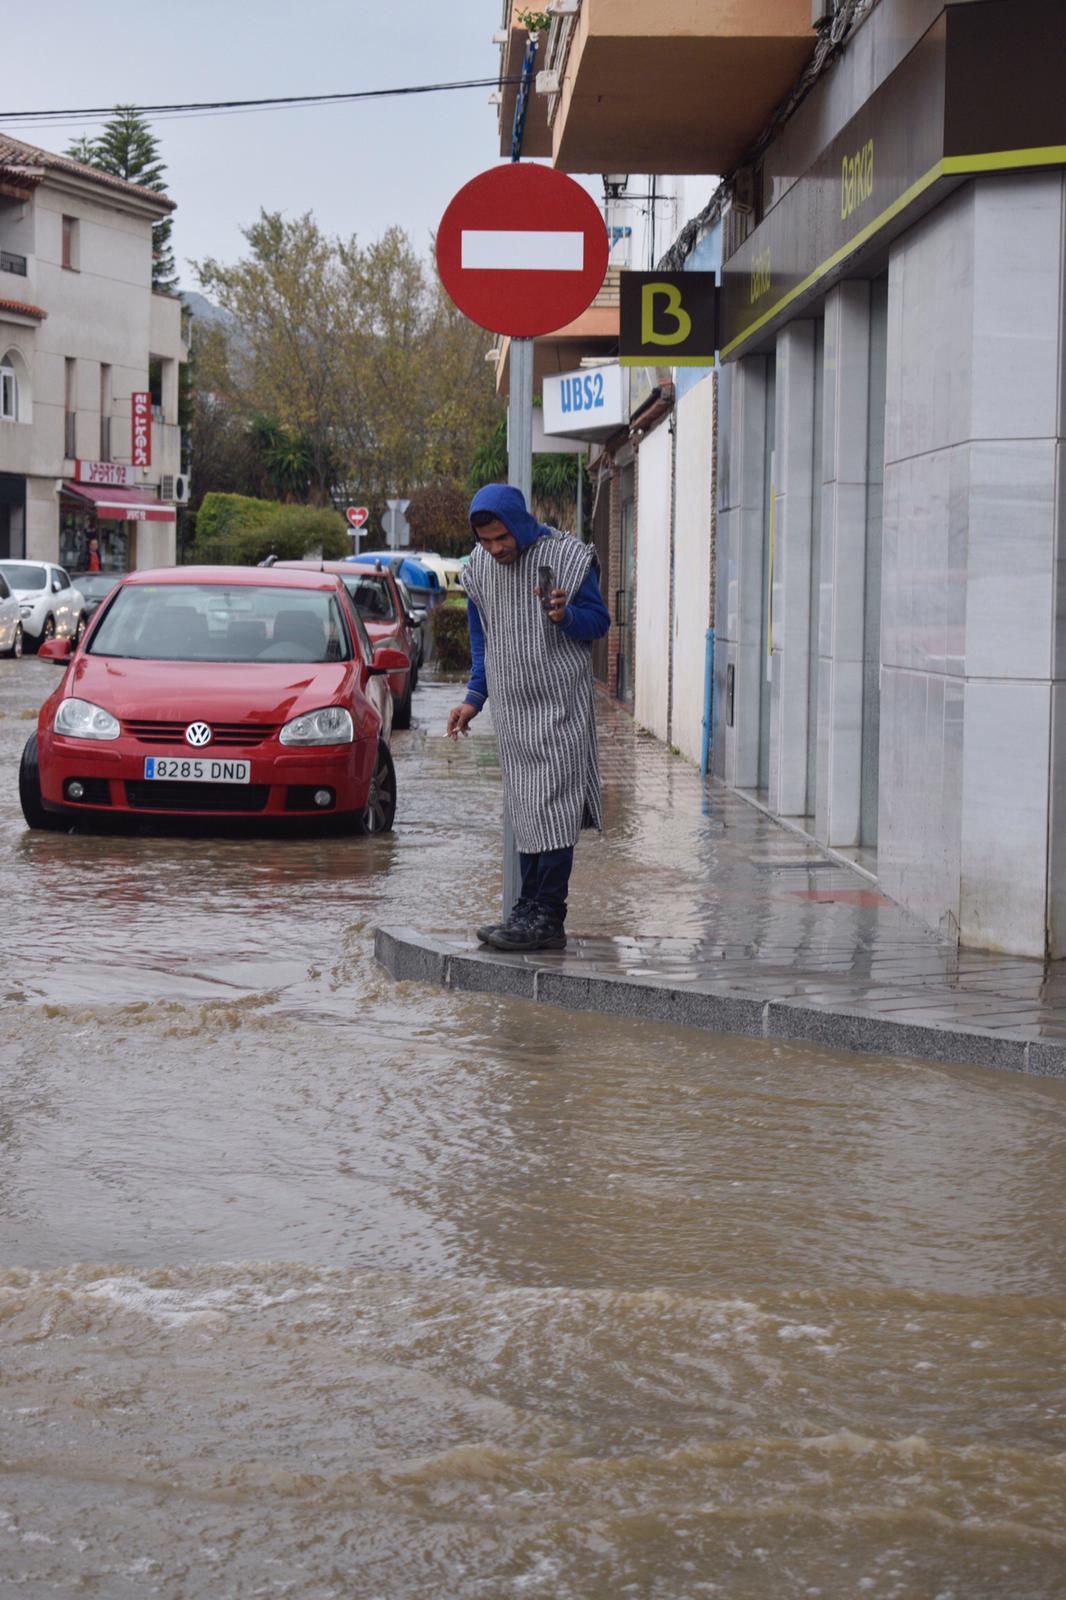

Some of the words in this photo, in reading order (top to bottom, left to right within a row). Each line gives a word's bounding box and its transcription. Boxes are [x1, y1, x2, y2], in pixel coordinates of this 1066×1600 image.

[841, 138, 874, 220] Bankia
[641, 282, 692, 346] B
[135, 394, 147, 414] 92
[560, 372, 605, 414] UBS2
[135, 417, 147, 465] SPORT
[89, 463, 115, 483] SPORT
[116, 465, 126, 484] 92
[156, 760, 204, 778] 8285
[211, 762, 247, 780] DND
